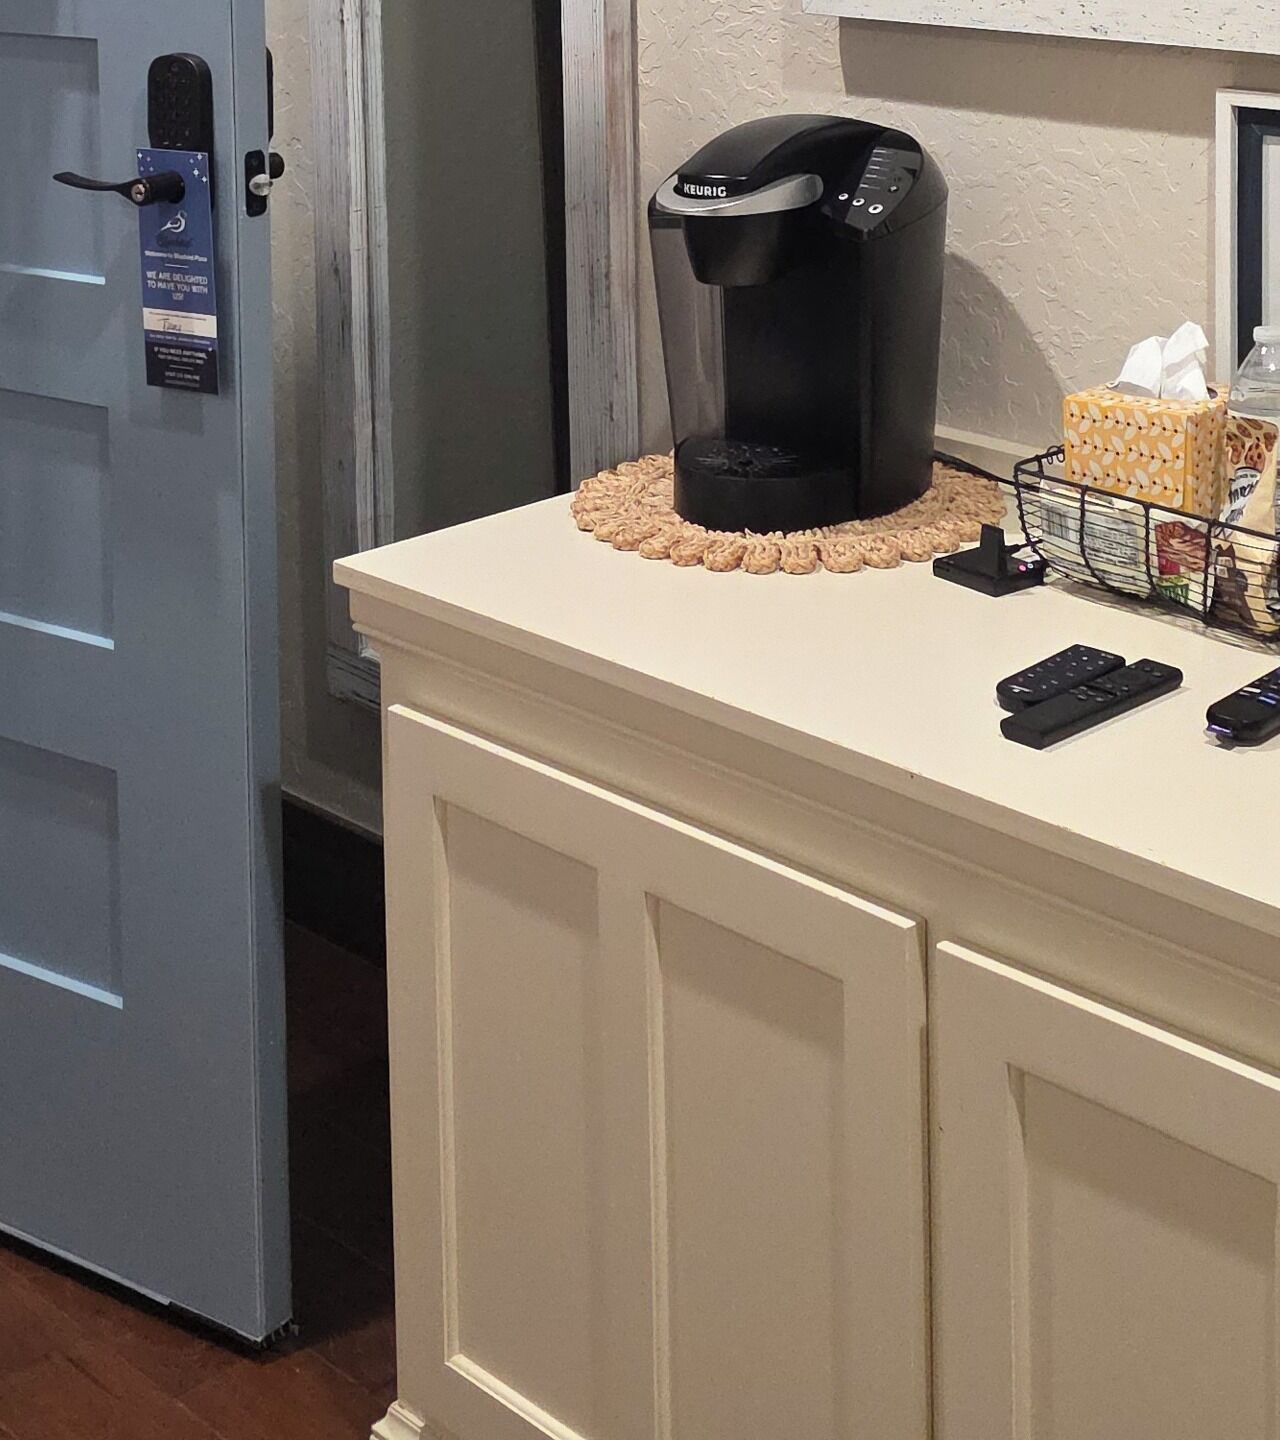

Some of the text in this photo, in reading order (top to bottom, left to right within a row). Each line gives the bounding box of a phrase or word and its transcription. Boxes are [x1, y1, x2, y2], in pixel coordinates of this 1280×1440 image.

[683, 183, 727, 197] KEURIG
[146, 271, 208, 285] WE ARE DELIGHTED
[147, 280, 208, 294] TO HAVE YOU WITH
